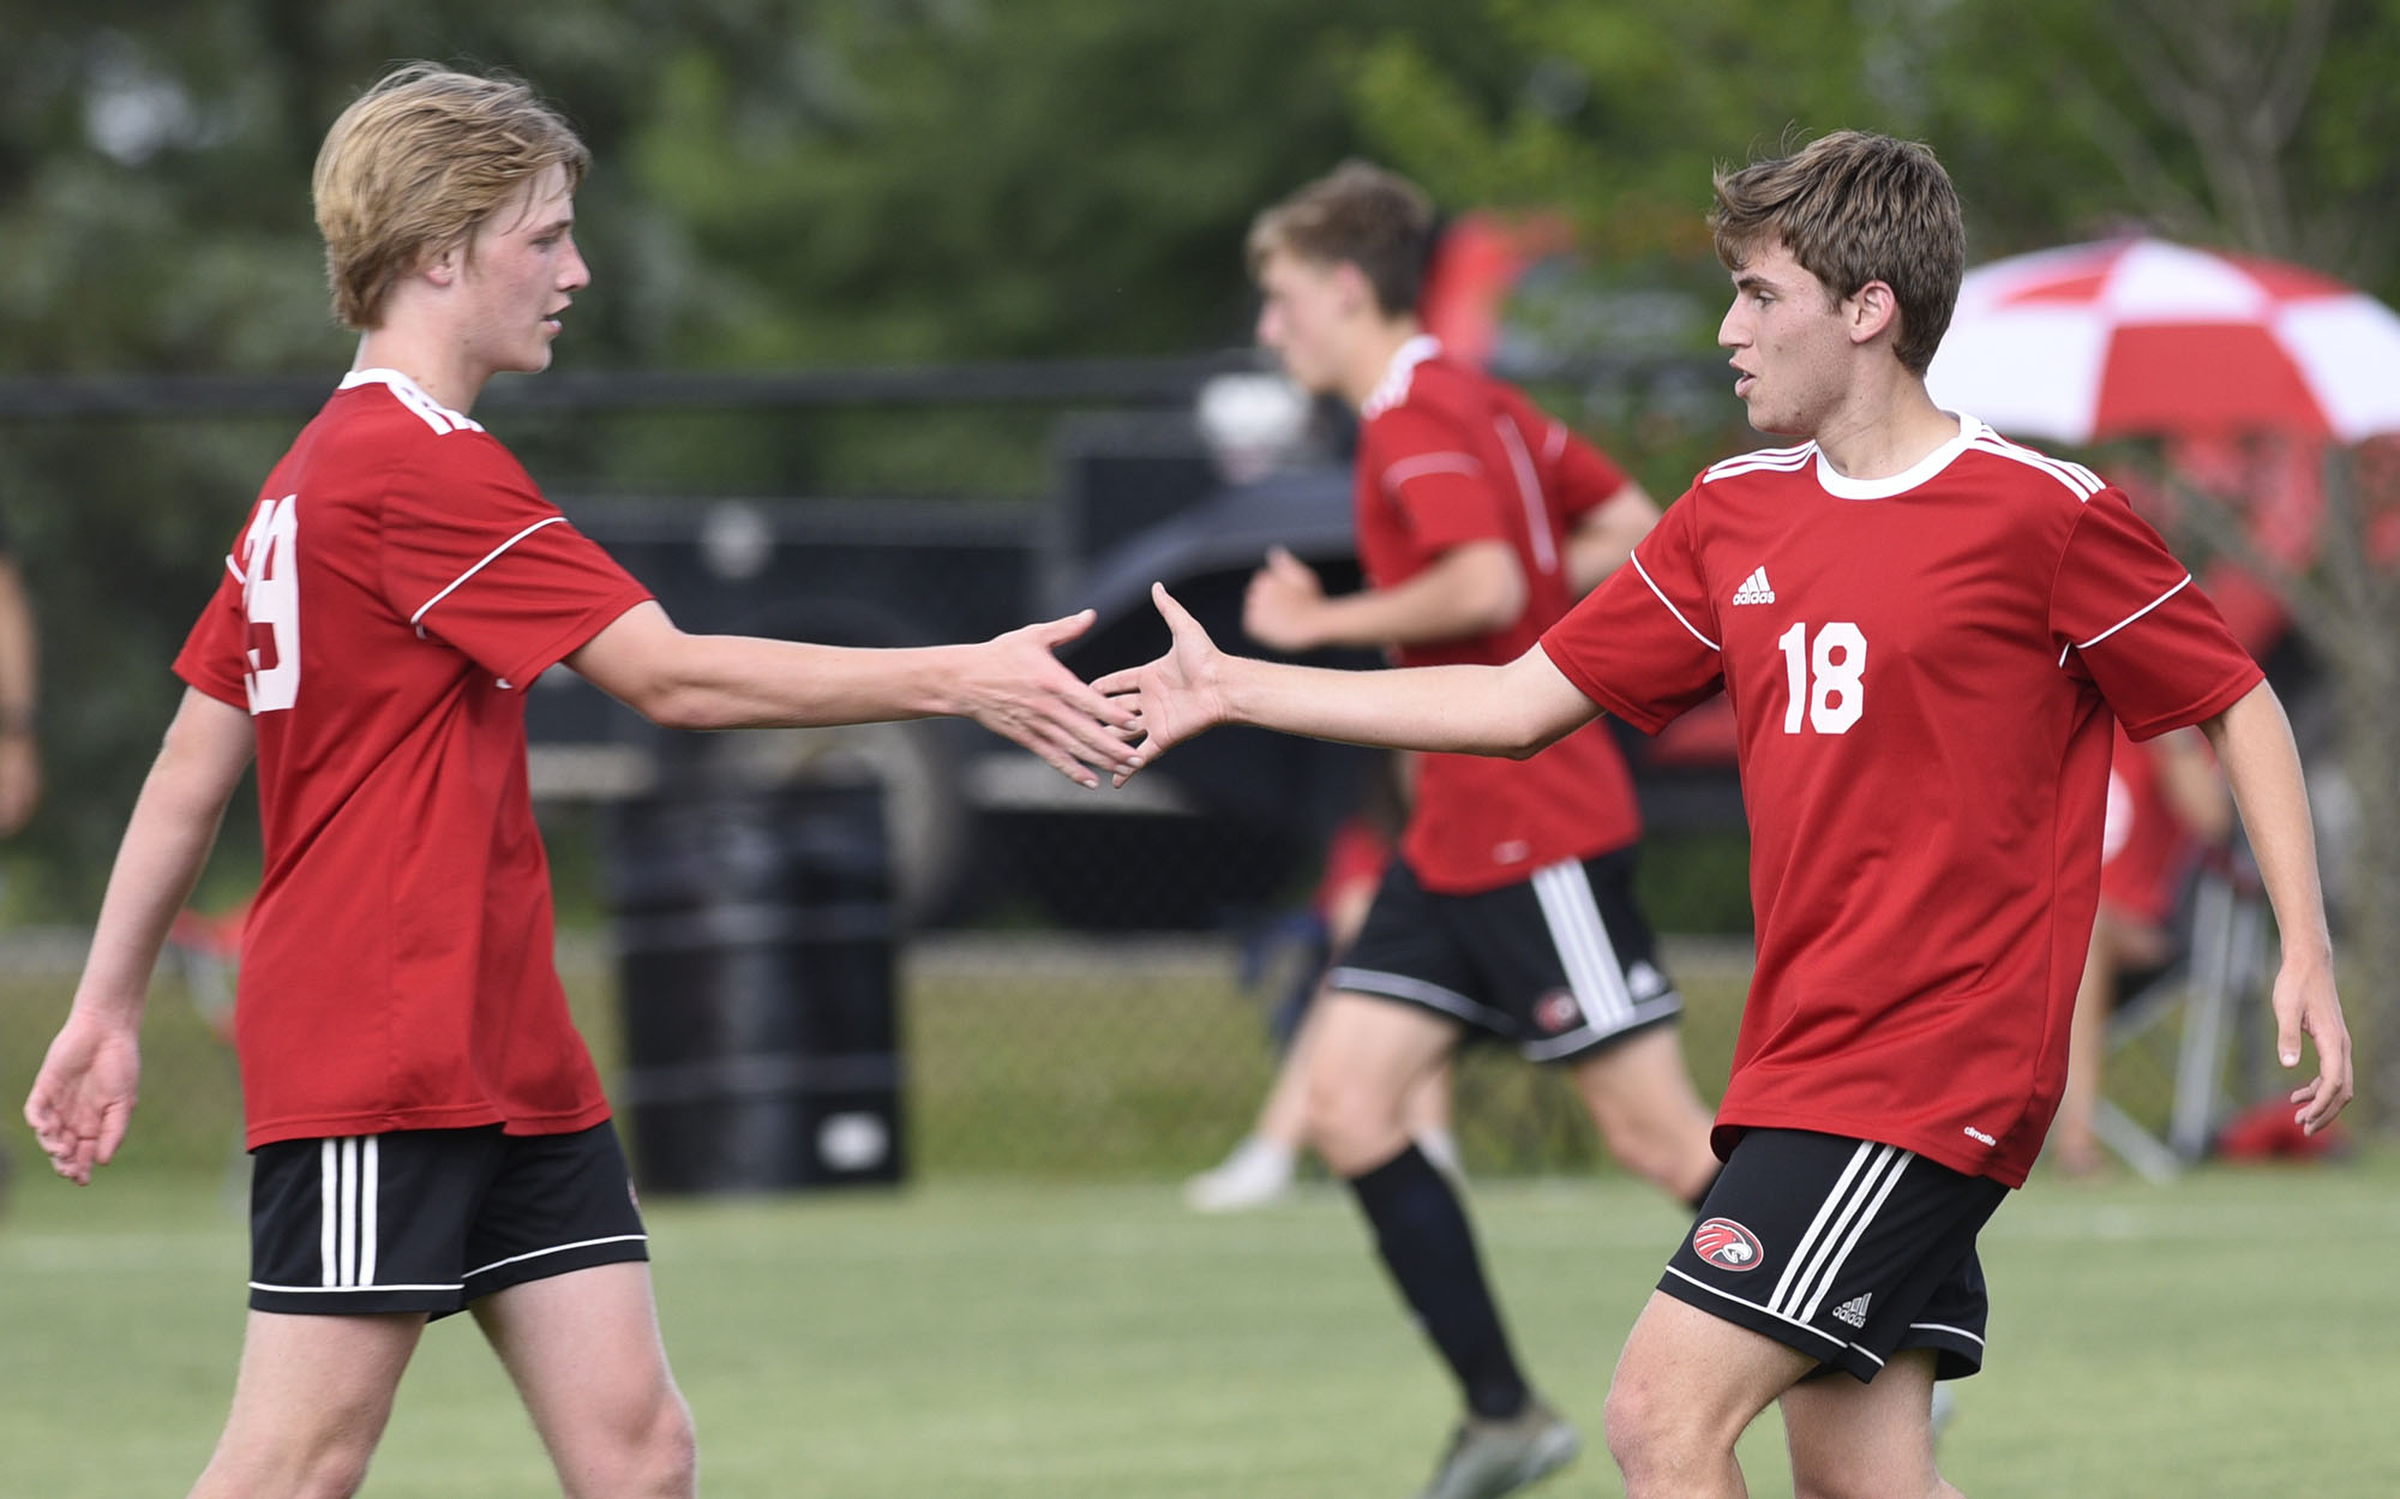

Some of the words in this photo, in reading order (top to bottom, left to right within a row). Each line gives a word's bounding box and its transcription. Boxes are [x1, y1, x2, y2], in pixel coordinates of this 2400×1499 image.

[1732, 590, 1776, 606] adidas
[1778, 622, 1868, 735] 18
[1832, 1306, 1866, 1329] adidas
